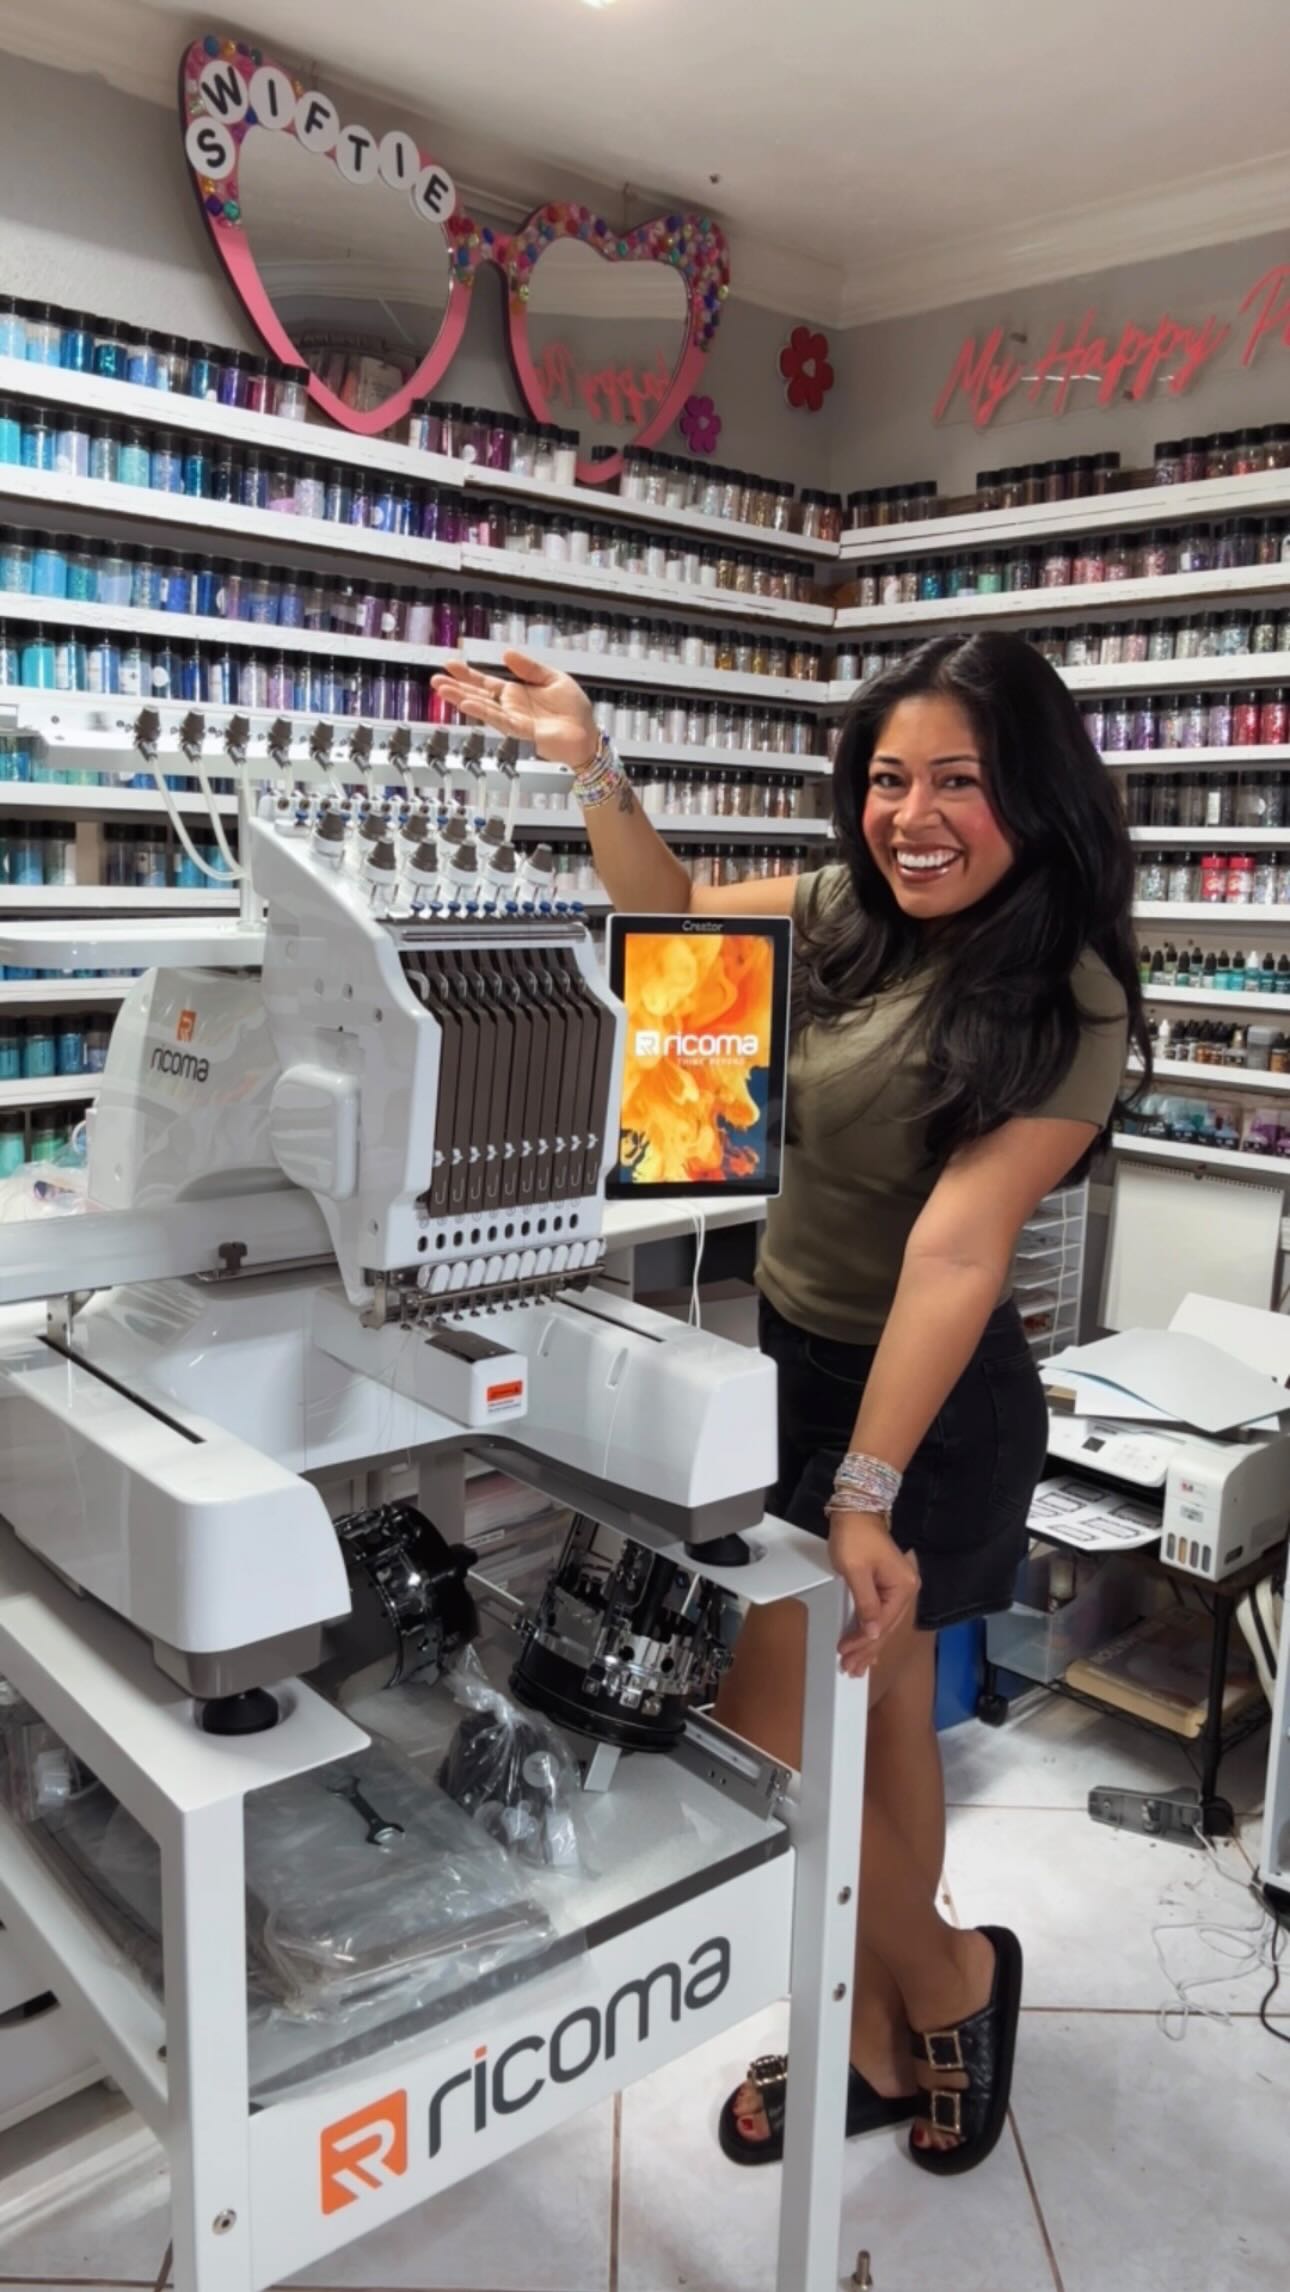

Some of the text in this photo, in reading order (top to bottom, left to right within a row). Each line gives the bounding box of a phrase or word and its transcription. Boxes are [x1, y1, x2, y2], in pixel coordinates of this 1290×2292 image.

[195, 64, 450, 214] SWIFTIE
[931, 323, 1025, 430] My
[1027, 307, 1232, 417] Happy
[681, 919, 724, 932] Creator
[150, 1045, 210, 1083] ricoma
[663, 1032, 758, 1057] ricoma
[429, 1936, 731, 2160] ricoma
